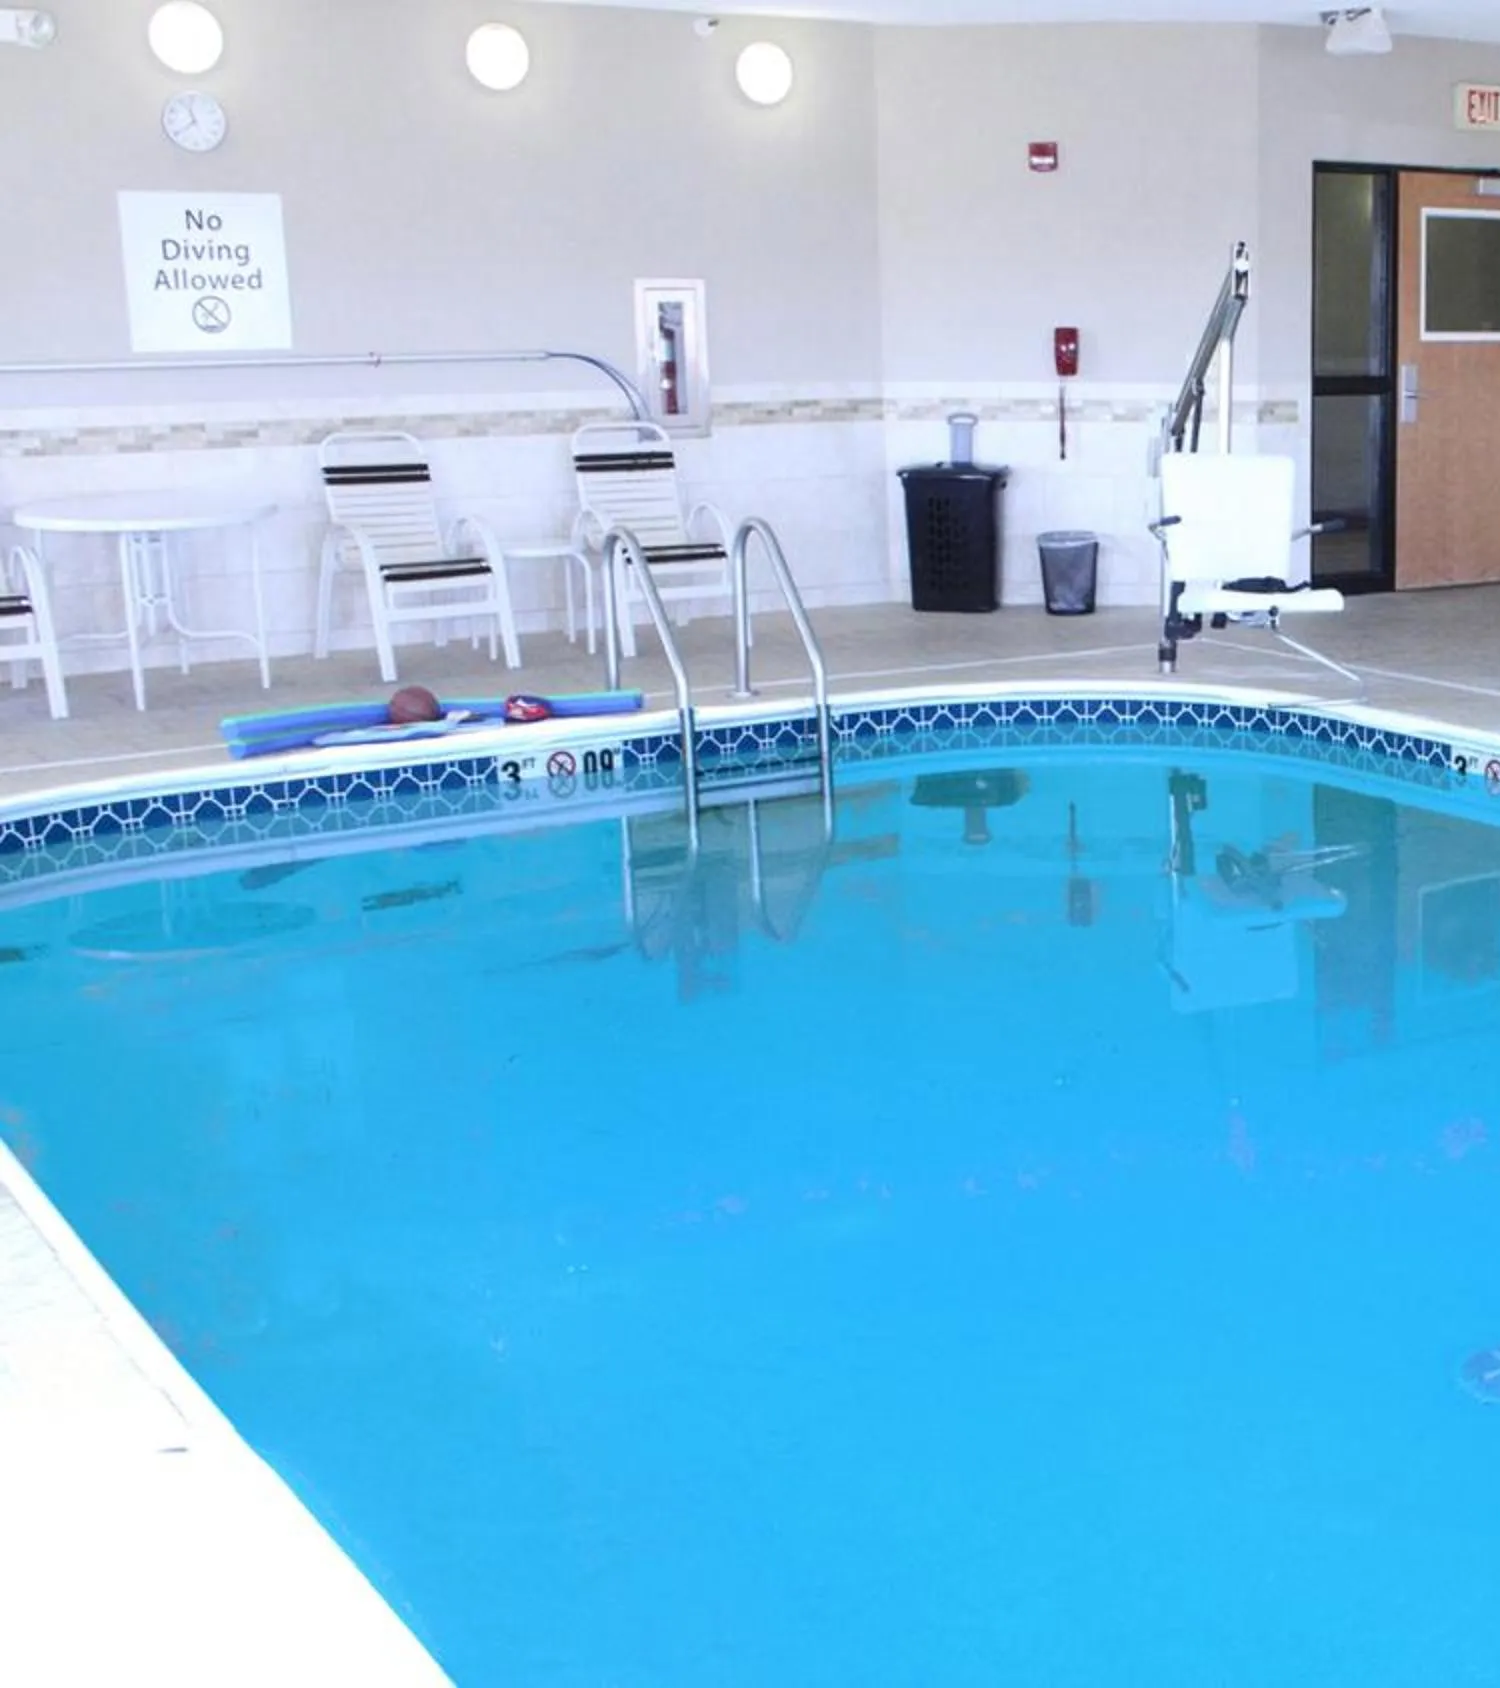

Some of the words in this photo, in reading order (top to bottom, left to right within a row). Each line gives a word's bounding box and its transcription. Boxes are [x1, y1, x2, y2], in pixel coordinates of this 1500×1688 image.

[1467, 89, 1500, 124] EXIT
[185, 209, 223, 232] No
[161, 239, 250, 267] Diving
[154, 268, 263, 291] Allowed
